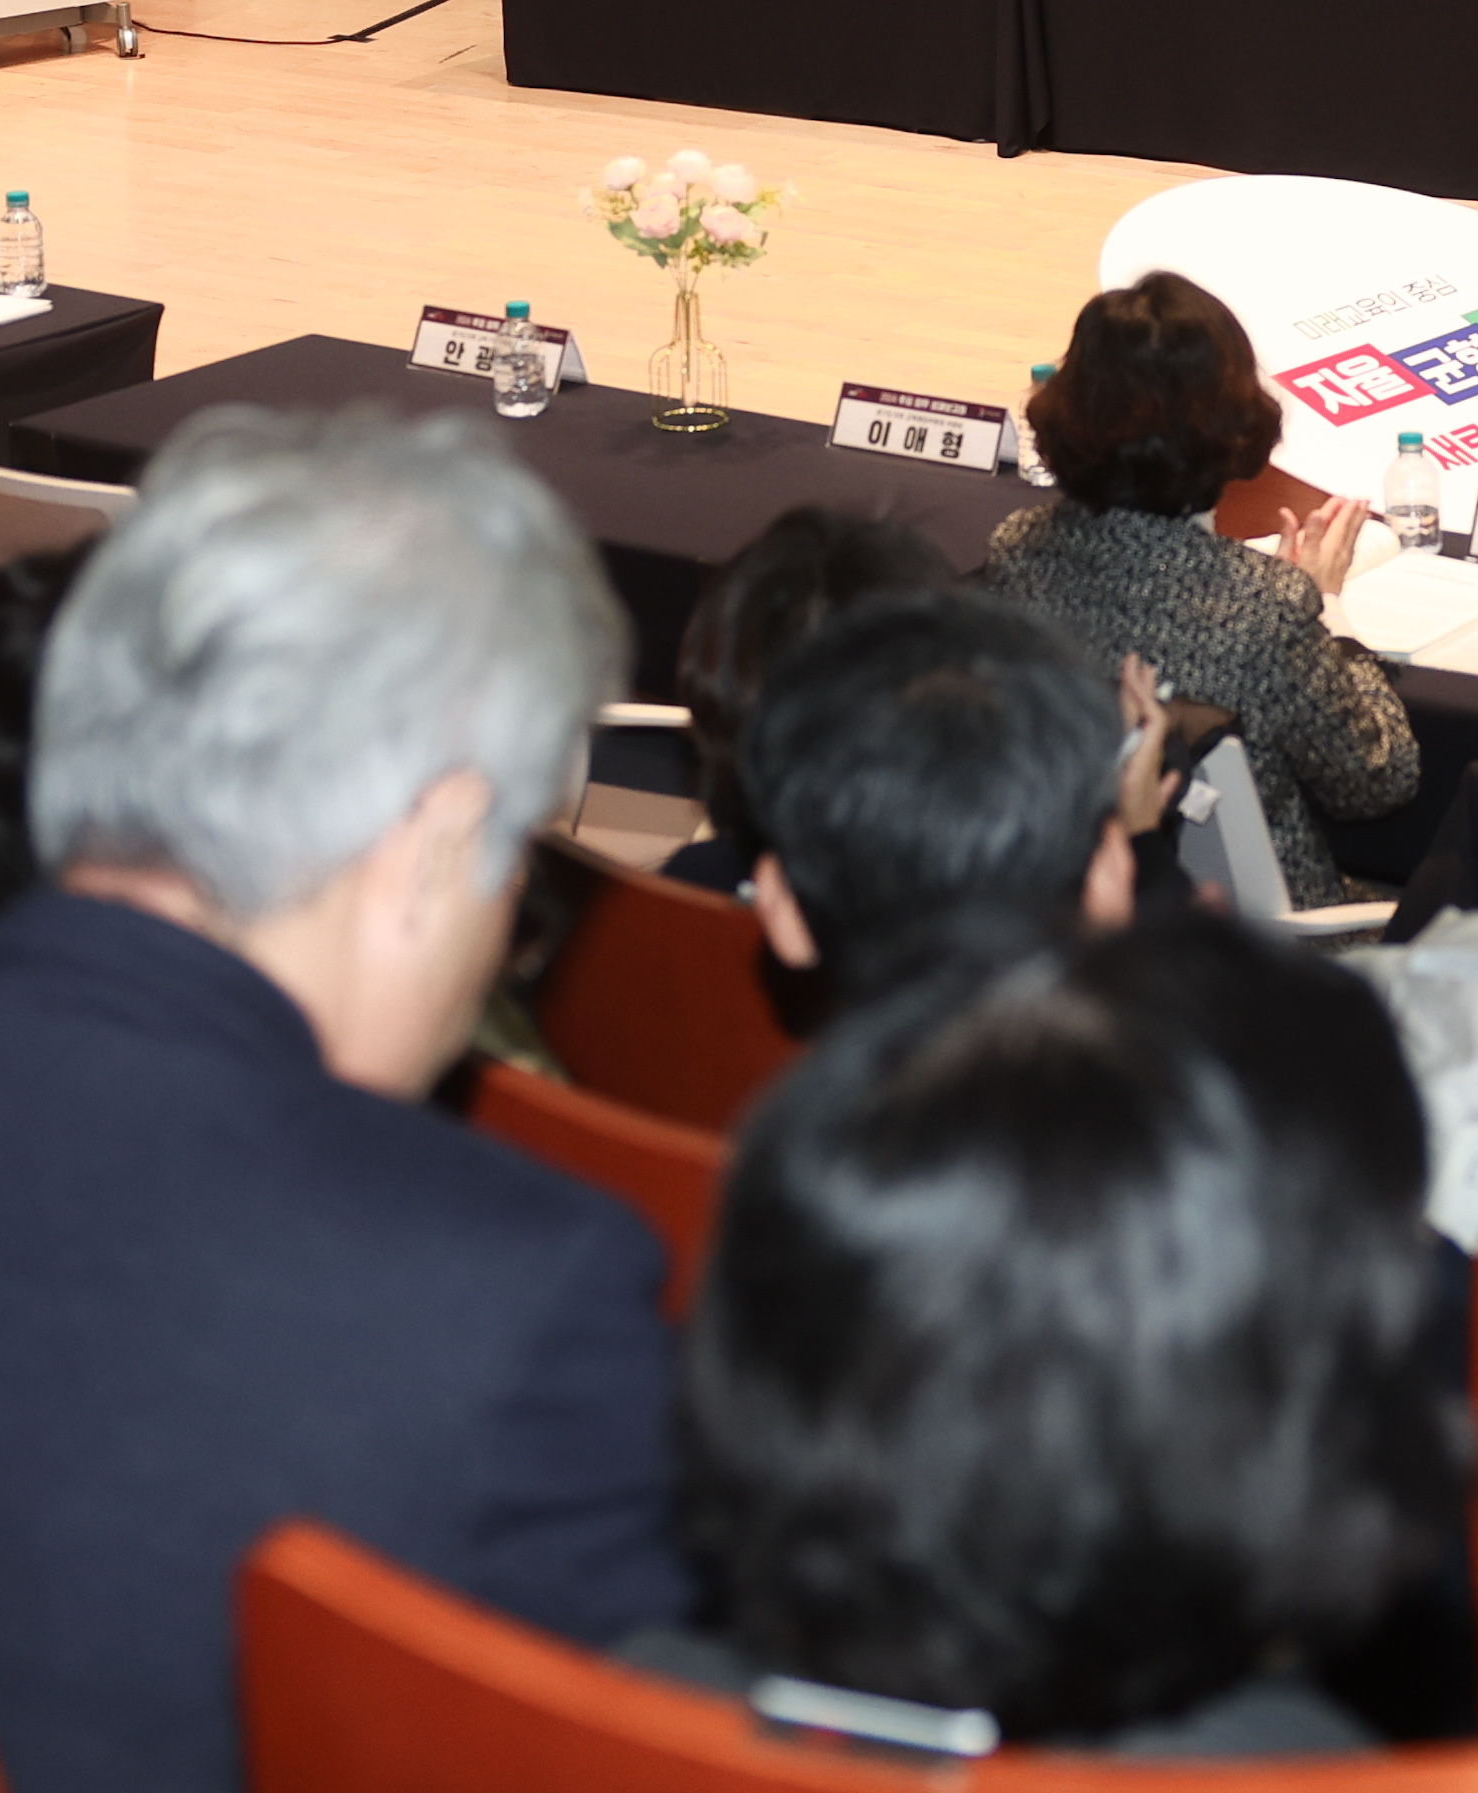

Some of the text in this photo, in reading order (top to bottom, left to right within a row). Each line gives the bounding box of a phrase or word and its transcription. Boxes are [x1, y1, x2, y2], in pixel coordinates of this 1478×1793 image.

[1293, 274, 1458, 340] 미래교육의 중심
[1291, 354, 1415, 415] 자율
[868, 420, 963, 458] 이애형
